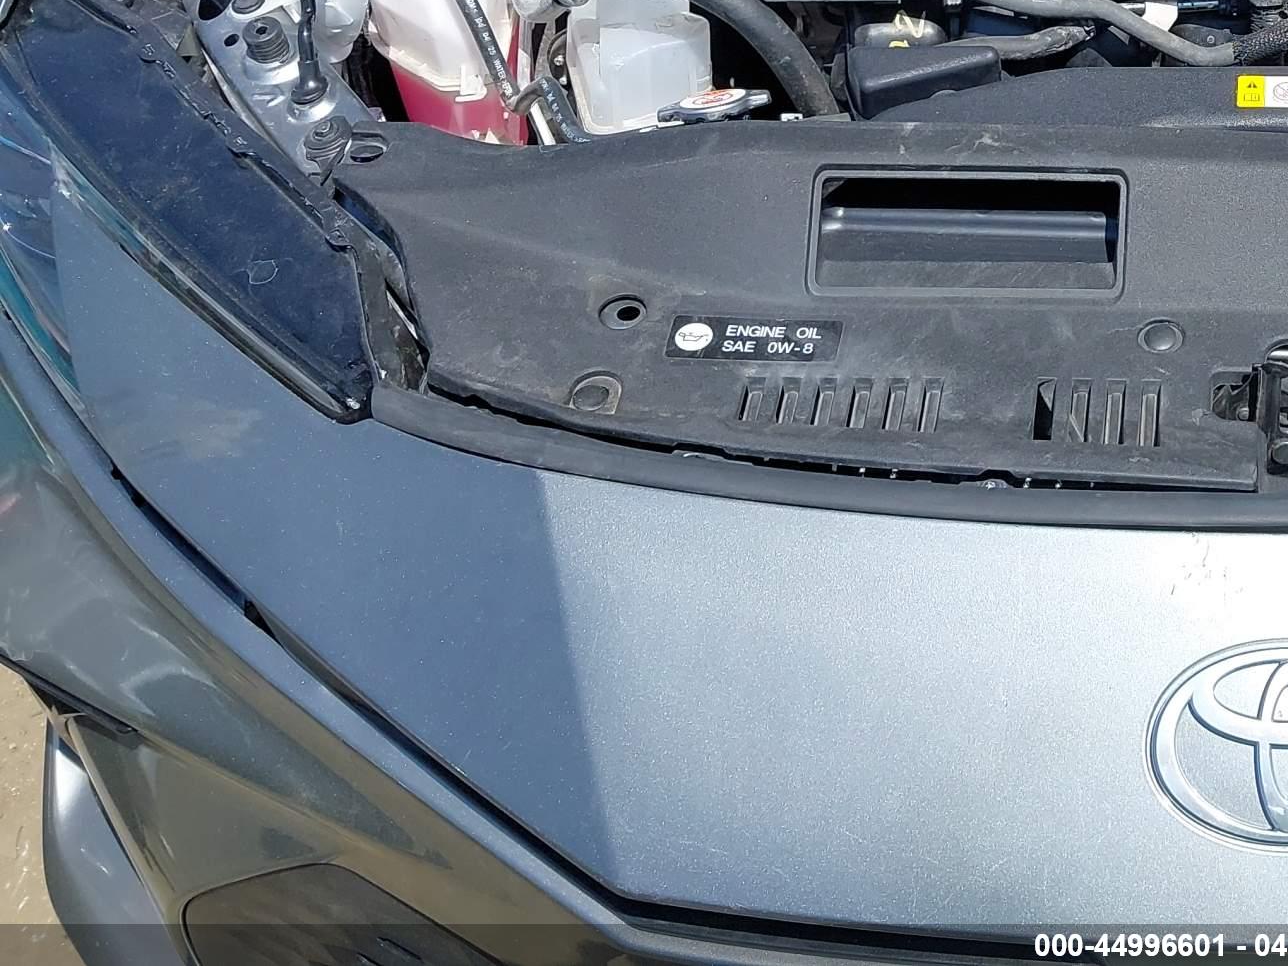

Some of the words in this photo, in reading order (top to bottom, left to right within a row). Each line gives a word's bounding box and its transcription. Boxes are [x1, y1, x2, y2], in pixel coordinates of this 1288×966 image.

[493, 58, 506, 79] WATER
[725, 325, 786, 338] ENGINE
[796, 327, 822, 339] OIL
[721, 340, 756, 353] SAE
[767, 341, 814, 354] 0W-8
